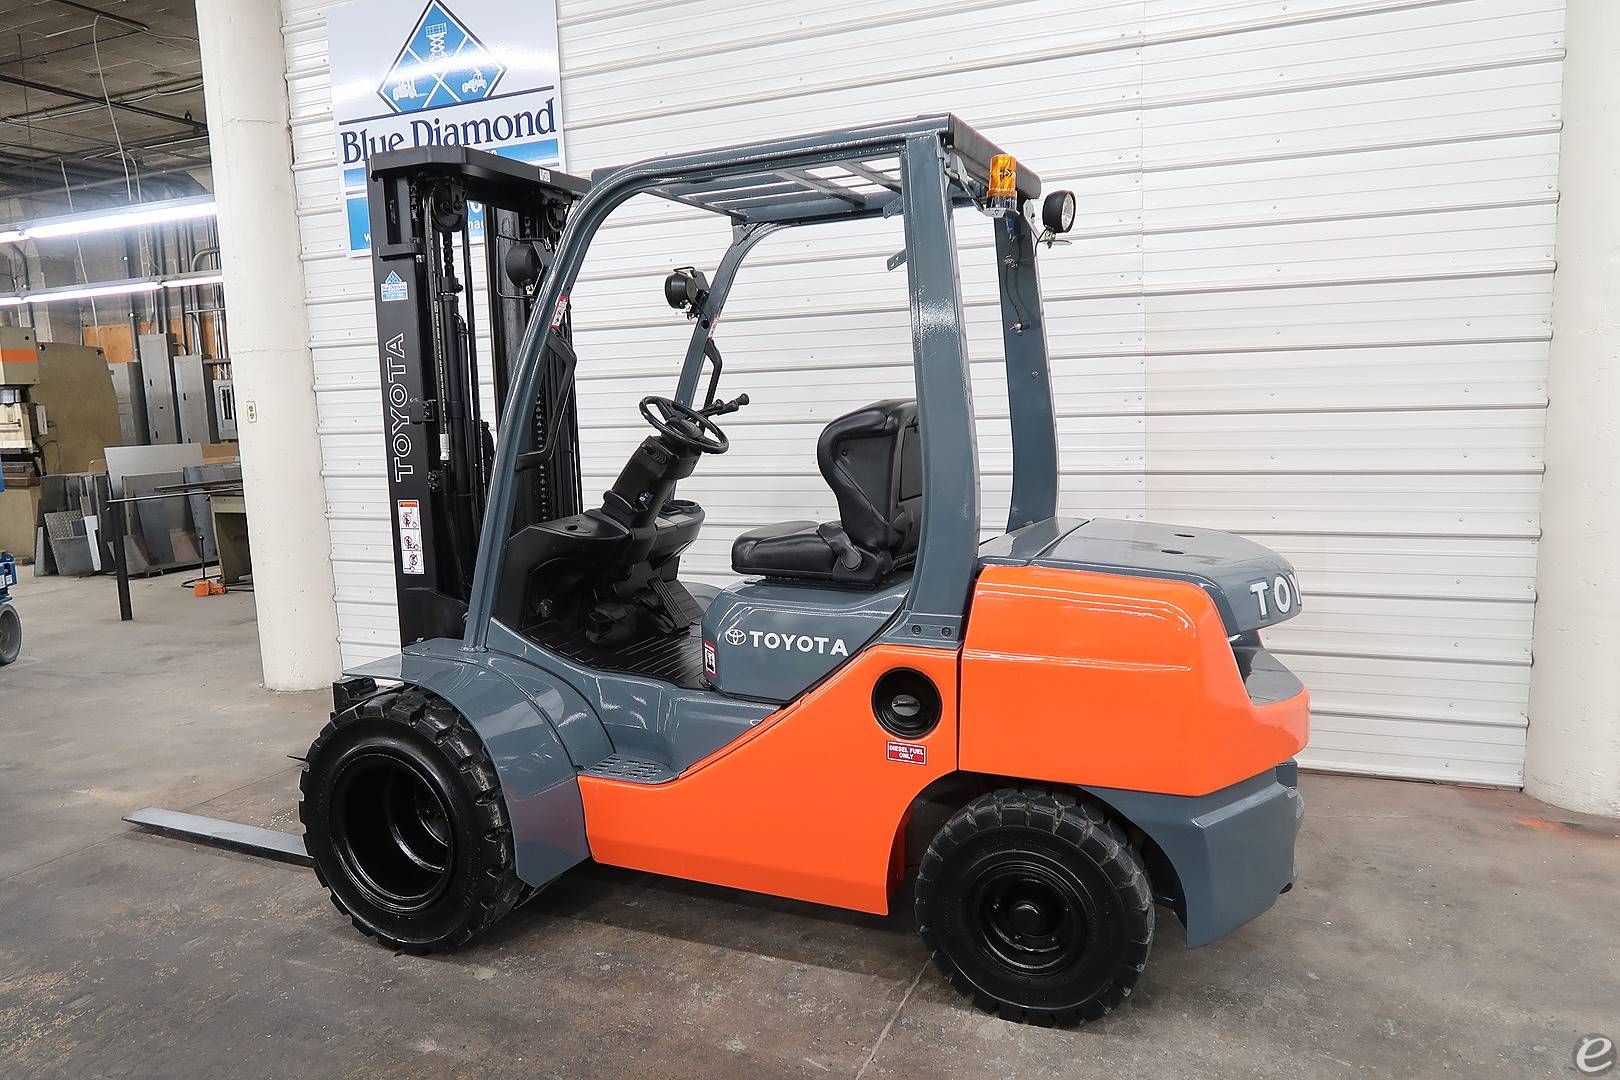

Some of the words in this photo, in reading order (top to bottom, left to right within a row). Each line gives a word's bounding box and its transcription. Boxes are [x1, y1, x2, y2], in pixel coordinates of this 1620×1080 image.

[340, 128, 404, 165] Blue
[410, 98, 557, 148] Diamond
[385, 333, 414, 483] TOYOTA
[750, 630, 849, 656] TOYOTA
[889, 745, 908, 753] DIESEL
[909, 747, 924, 755] FUEL
